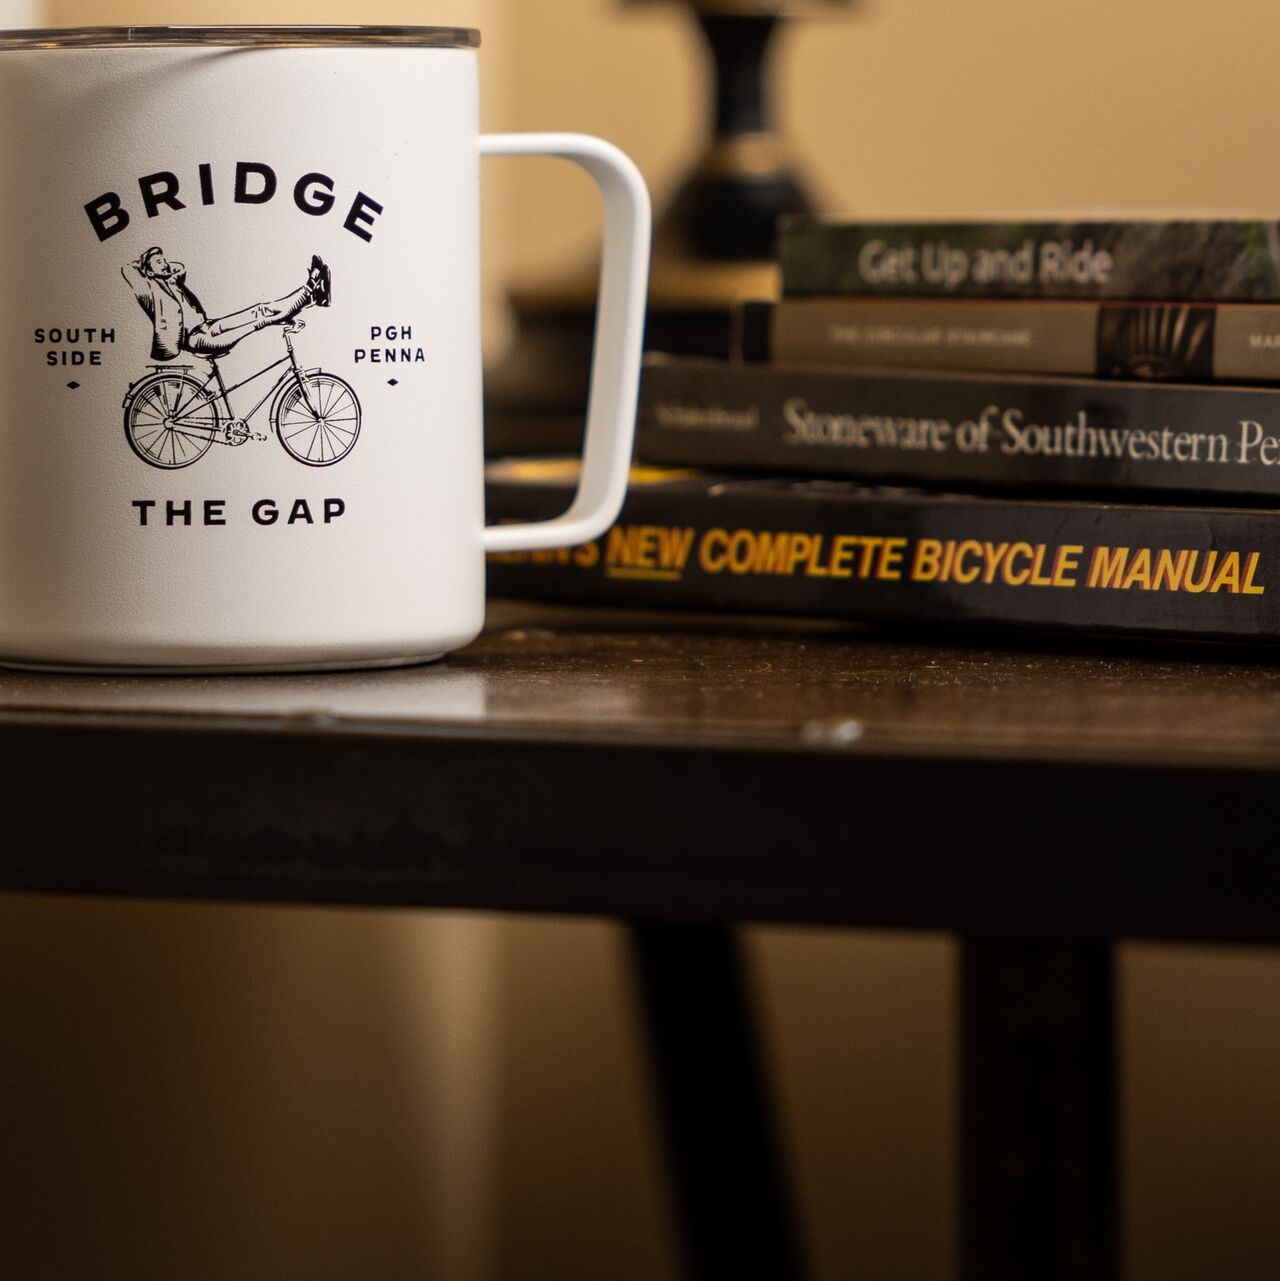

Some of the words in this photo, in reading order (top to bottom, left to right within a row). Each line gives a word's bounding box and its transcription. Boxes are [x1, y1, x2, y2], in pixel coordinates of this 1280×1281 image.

[83, 161, 384, 242] BRIDGE
[858, 239, 917, 285] Get
[922, 241, 969, 290] Up
[973, 240, 1034, 284] and
[1039, 239, 1113, 284] Ride
[34, 328, 116, 344] SOUTH
[371, 325, 412, 341] PGH
[46, 350, 102, 366] SIDE
[354, 348, 425, 364] PENNA
[782, 397, 951, 449] Stoneware
[955, 405, 1000, 453] of
[1001, 408, 1229, 463] Southwestern
[132, 499, 227, 526] THE
[251, 498, 346, 525] GAP
[606, 524, 695, 570] NEW
[699, 530, 908, 580] COMPLETE
[912, 539, 1083, 589] BICYCLE
[1085, 546, 1265, 595] MANUAL
